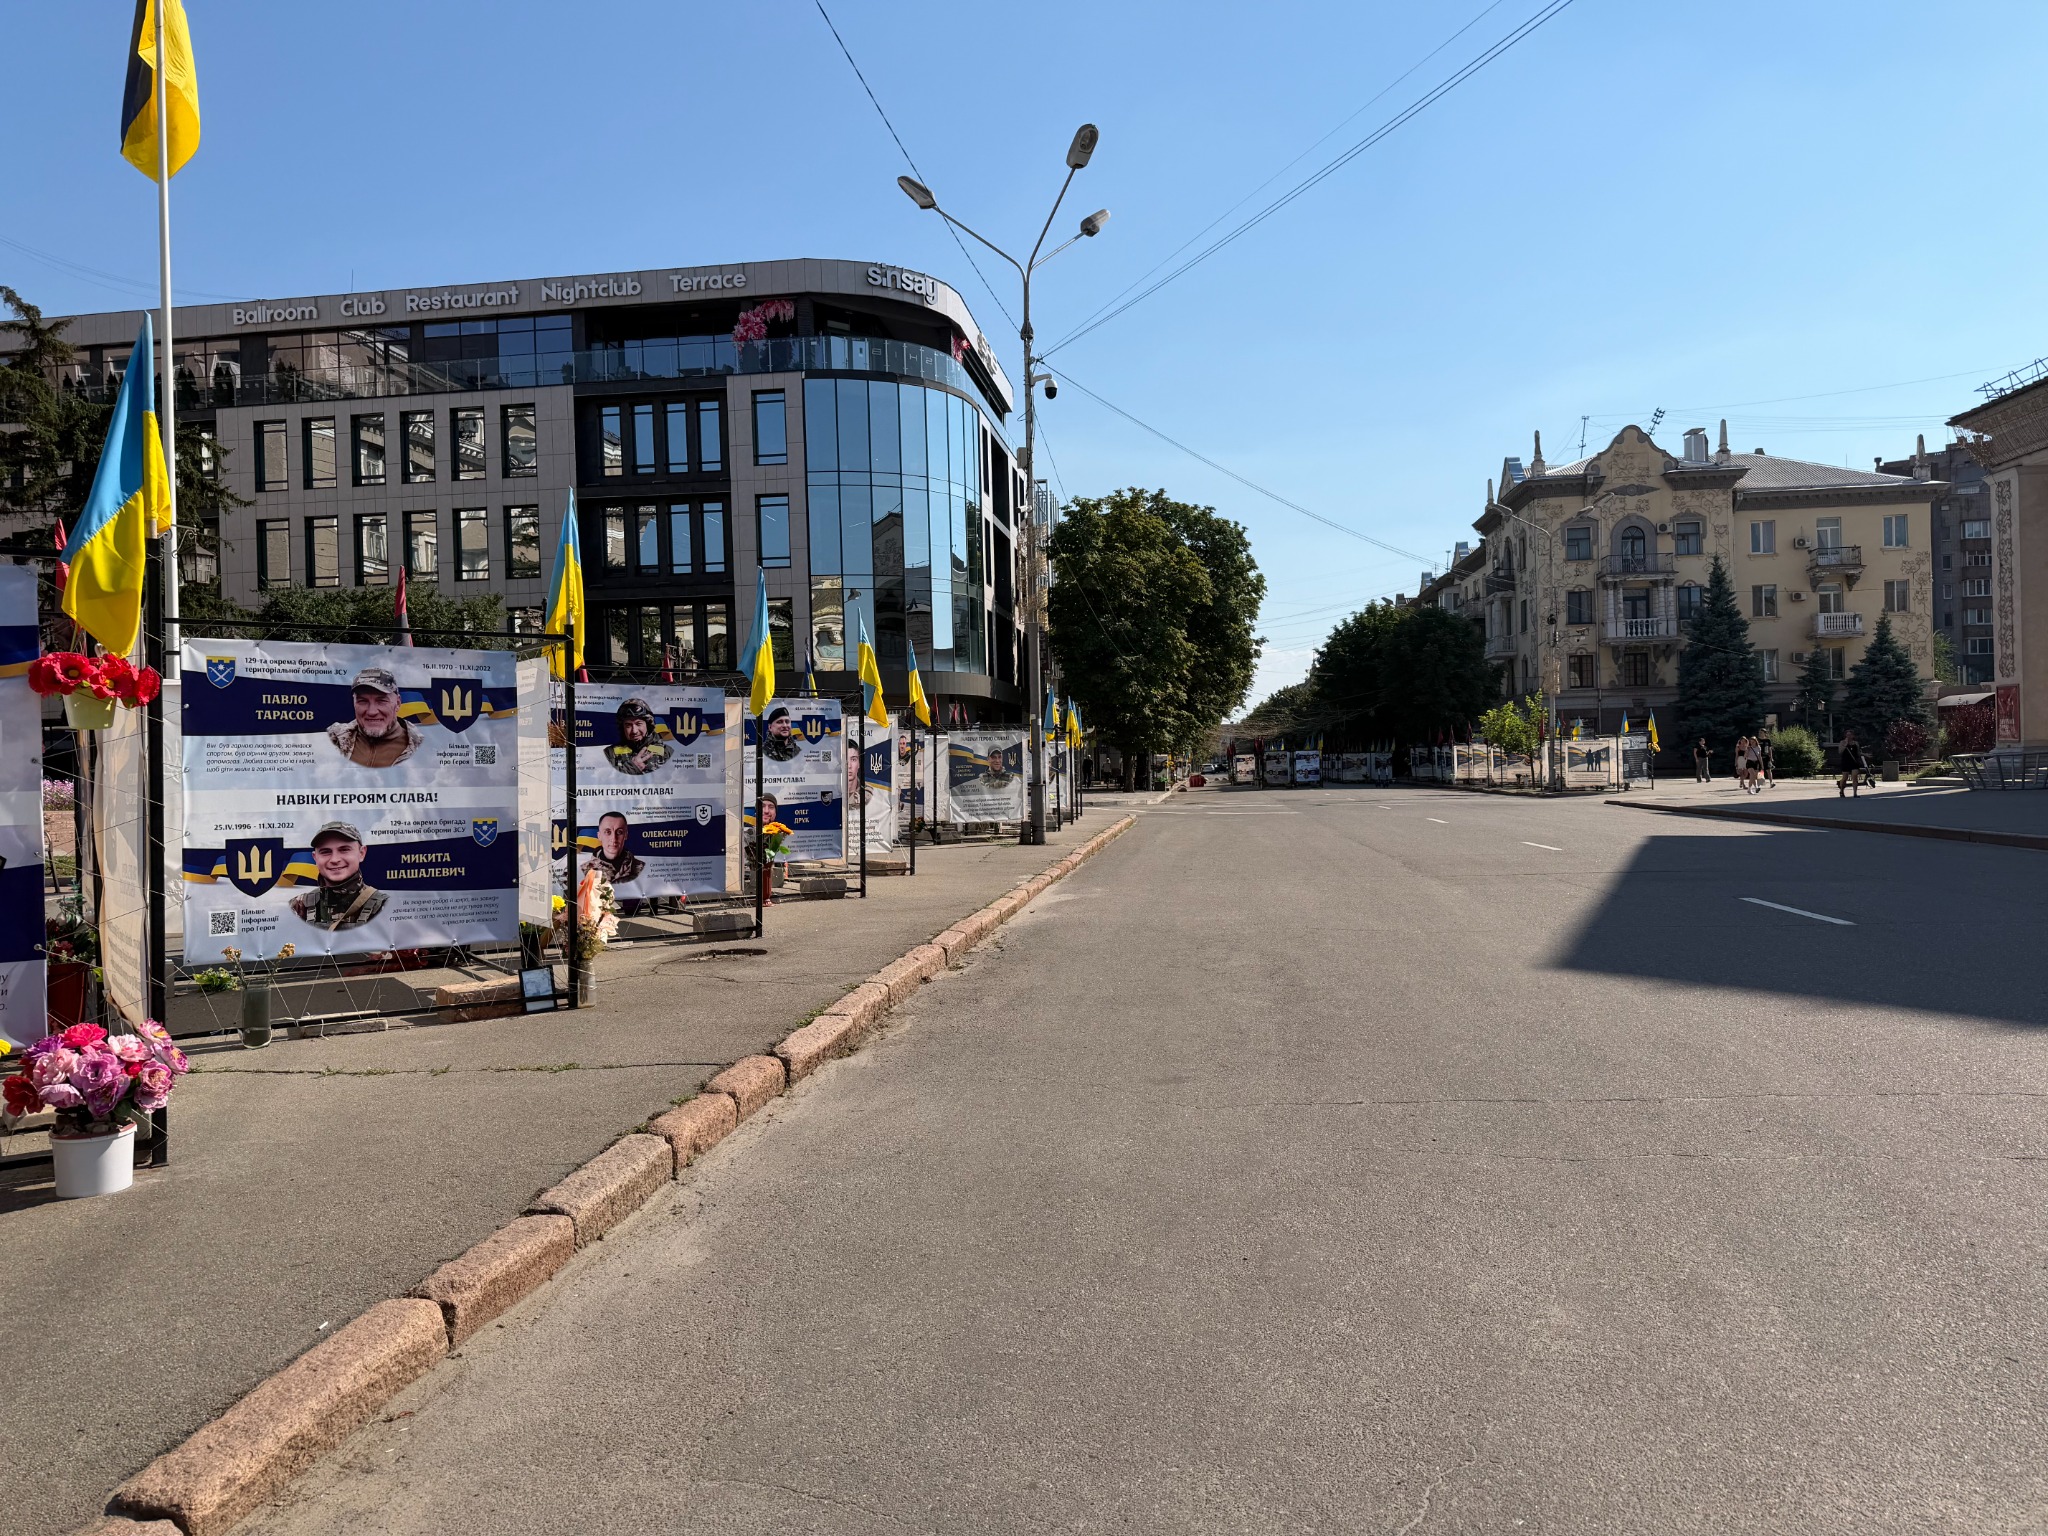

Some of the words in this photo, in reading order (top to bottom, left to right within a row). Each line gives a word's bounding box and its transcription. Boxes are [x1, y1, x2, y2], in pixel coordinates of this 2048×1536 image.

[867, 263, 938, 305] sinsay
[232, 304, 318, 326] Ballroom
[340, 297, 386, 317] Club
[406, 285, 520, 312] Restaurant
[541, 273, 642, 305] Nightclub
[670, 272, 747, 292] Terrace
[298, 658, 328, 667] бригада
[302, 668, 332, 676] оборони
[262, 694, 308, 704] ПАВЛО
[256, 710, 314, 720] ТАРАСОВ
[560, 719, 593, 727] ВИЛЬ
[577, 788, 604, 797] АВІКИ
[606, 788, 640, 796] ГЕРОЯМ
[642, 787, 674, 796] СЛАВА!
[276, 794, 330, 806] НАВІКИ
[334, 794, 387, 804] ГЕРОЯМ
[390, 792, 438, 804] СЛАВА!
[642, 830, 689, 838] ОЛЕКСАНДР
[649, 840, 682, 849] ЧЕПИГІН
[401, 852, 451, 864] МИКИТА
[386, 867, 466, 880] ШАШАЛЕВИЧ
[241, 916, 279, 924] інформації
